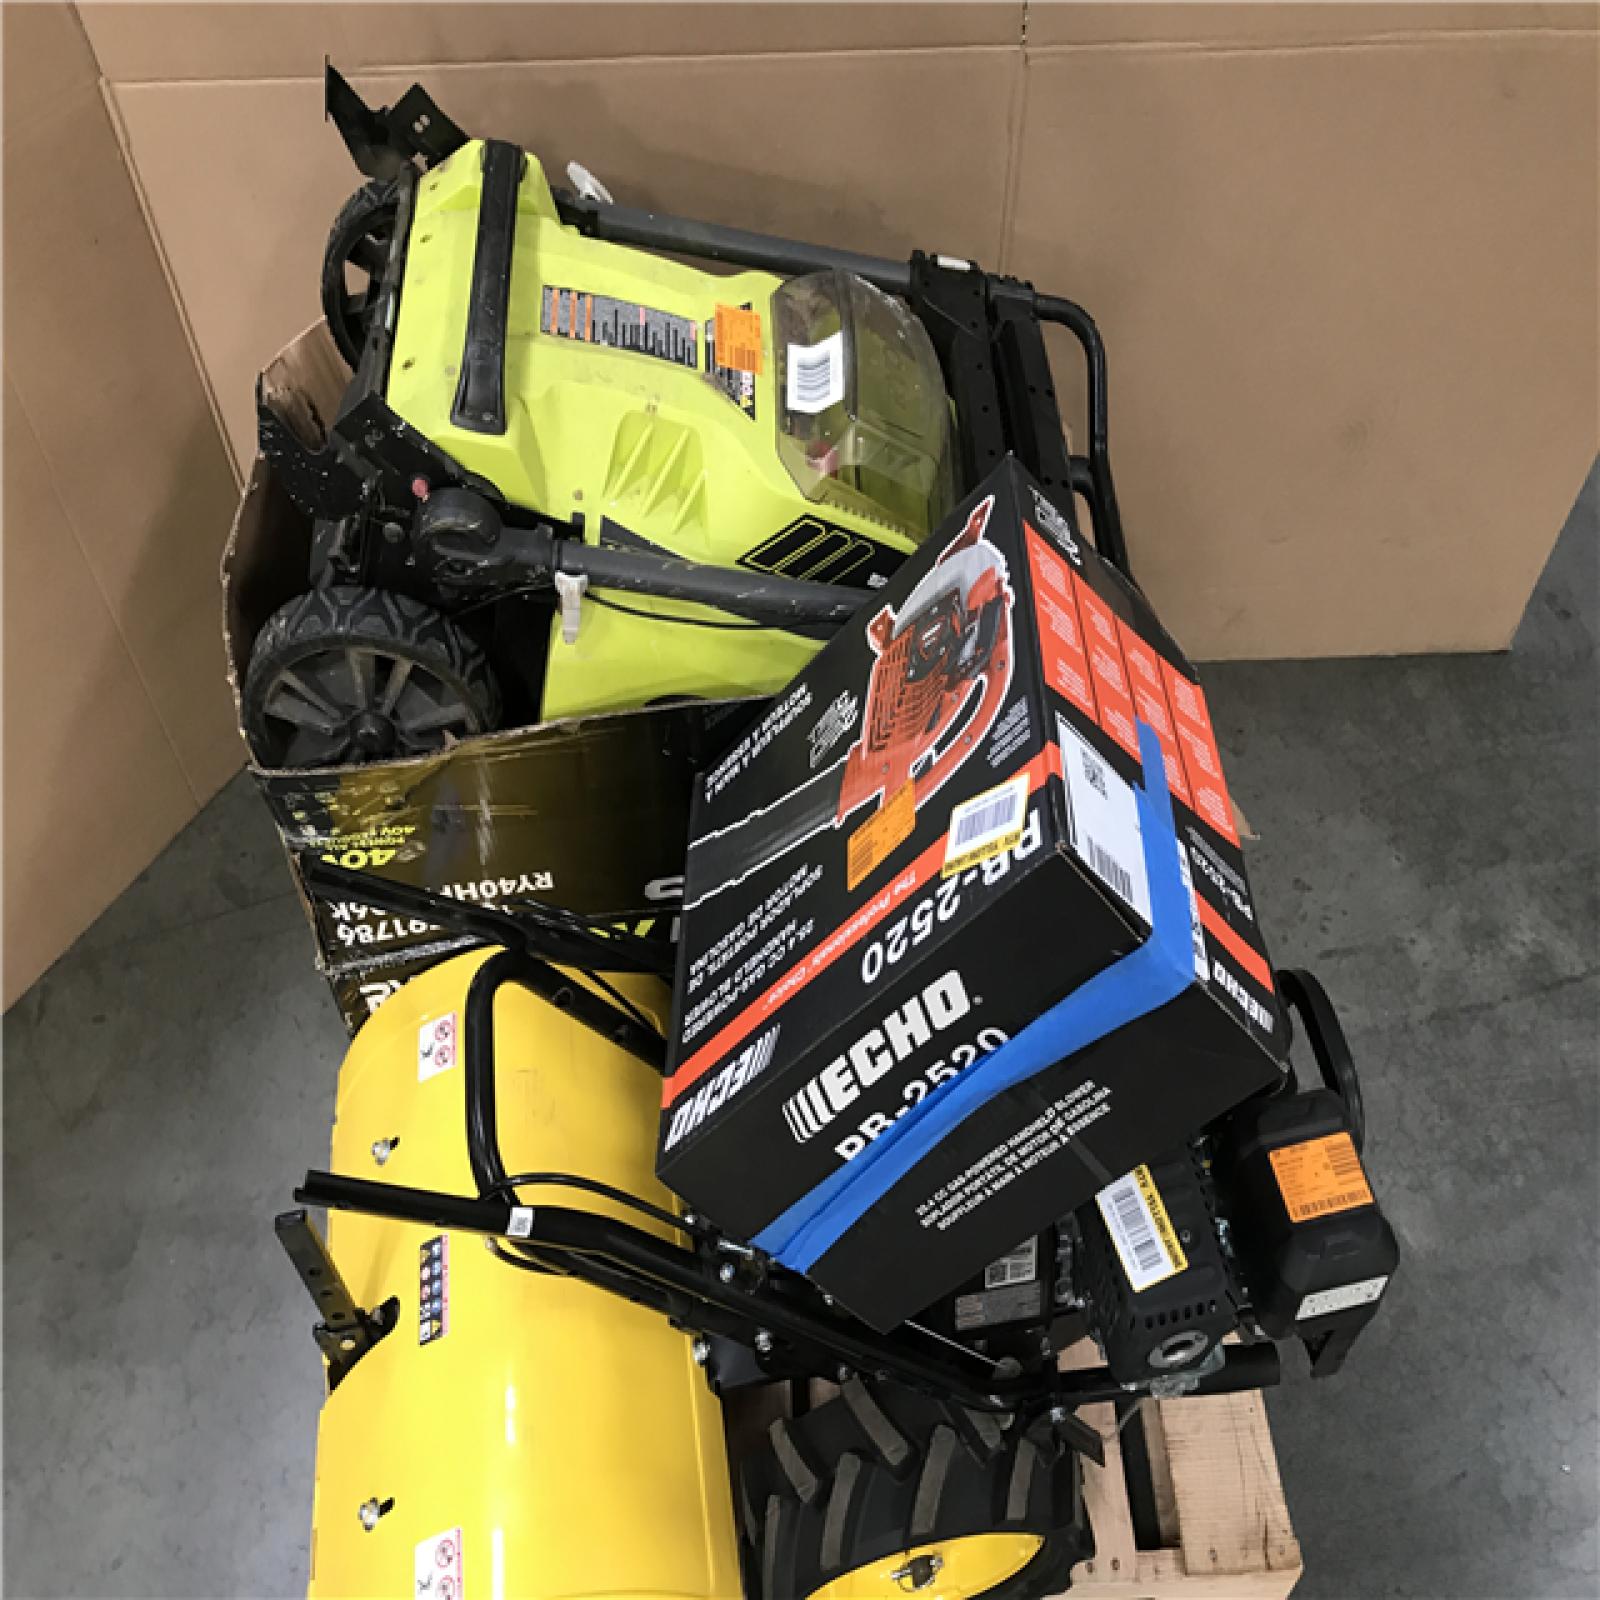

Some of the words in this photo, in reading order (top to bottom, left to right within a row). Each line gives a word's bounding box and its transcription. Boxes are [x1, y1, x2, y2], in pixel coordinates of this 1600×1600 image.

[331, 901, 387, 919] 6K
[862, 808, 1042, 983] PB-2520
[819, 970, 971, 1112] ECHO
[1214, 959, 1260, 1022] ECHO
[664, 1045, 754, 1152] ECHO
